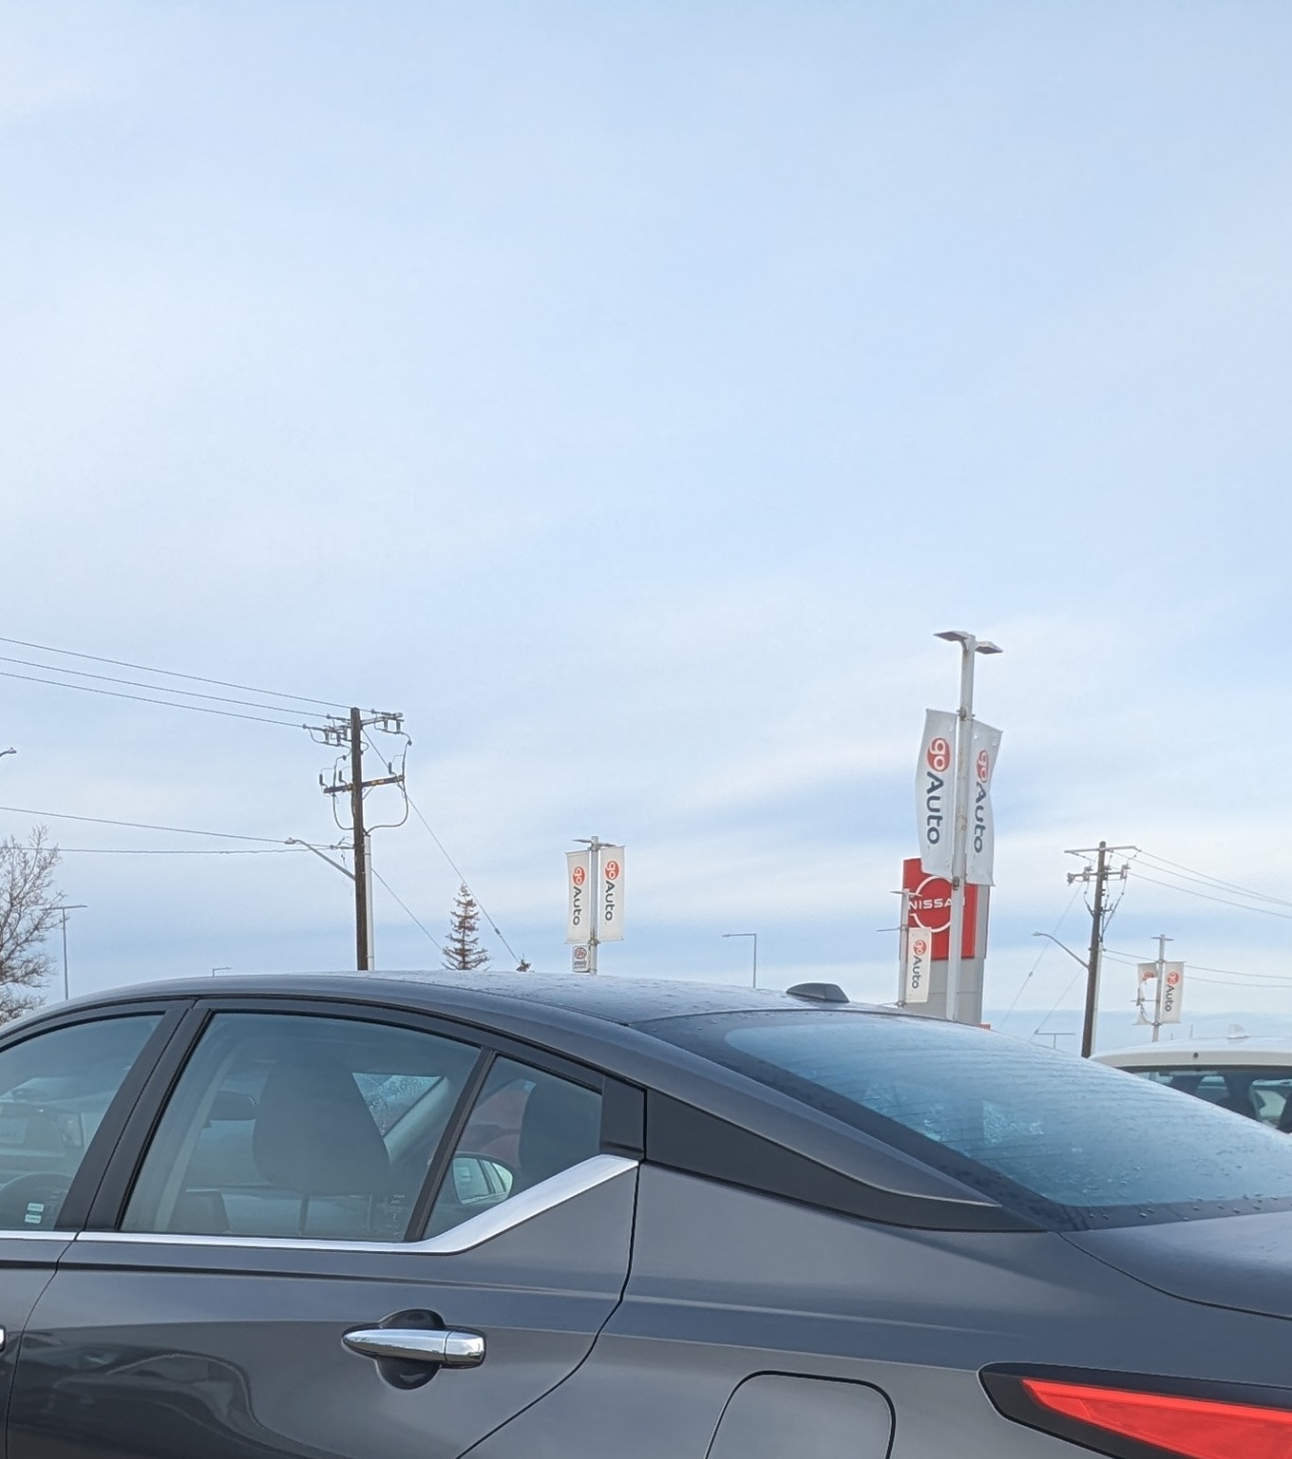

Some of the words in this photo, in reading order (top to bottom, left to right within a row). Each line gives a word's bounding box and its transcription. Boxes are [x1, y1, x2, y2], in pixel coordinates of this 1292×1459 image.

[929, 739, 947, 771] go
[926, 771, 944, 844] Auto
[973, 782, 987, 853] Auto
[572, 886, 583, 926] Auto
[604, 880, 616, 921] Auto
[908, 898, 965, 911] NISSA
[911, 955, 923, 989] Auto
[1164, 984, 1175, 1012] Auto
